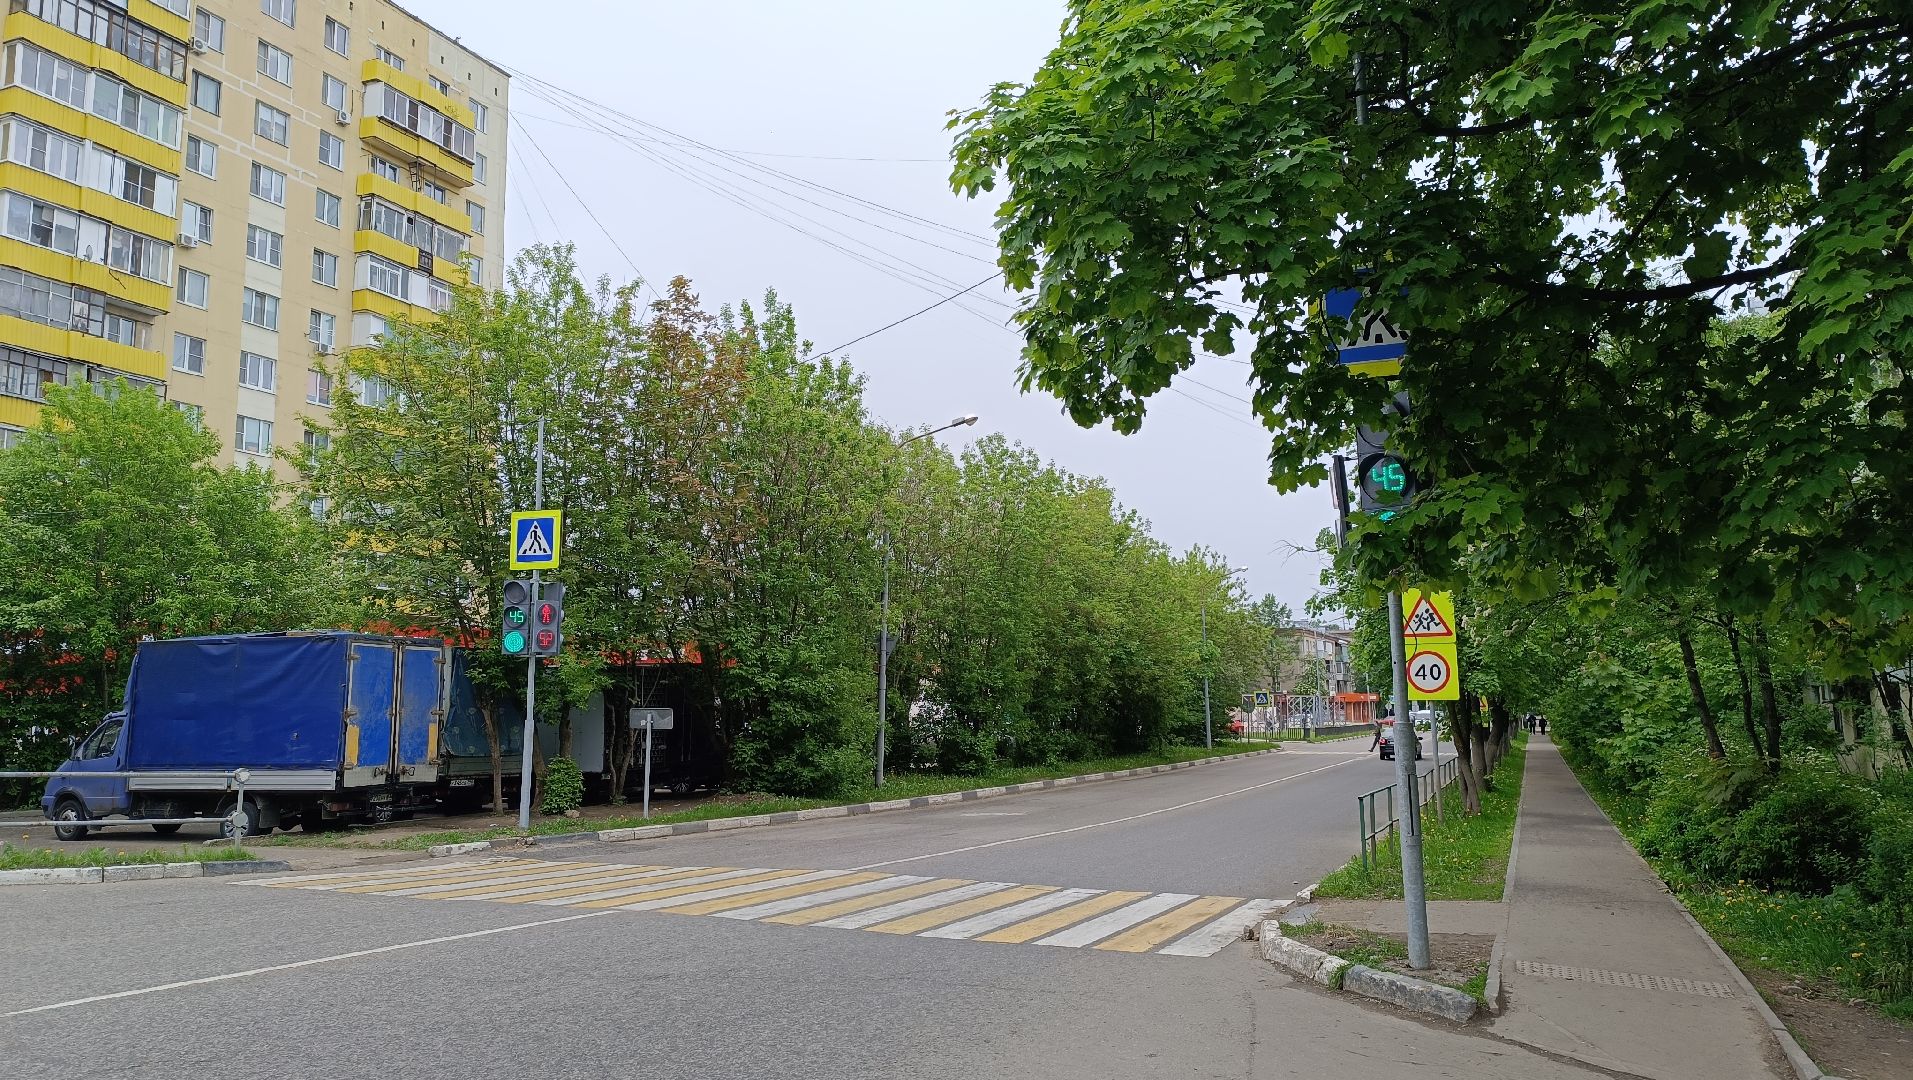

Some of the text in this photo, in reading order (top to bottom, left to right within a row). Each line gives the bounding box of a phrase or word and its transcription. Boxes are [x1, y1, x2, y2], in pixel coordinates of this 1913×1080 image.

[1372, 463, 1406, 491] 45
[510, 611, 524, 623] 45
[1415, 664, 1441, 681] 40
